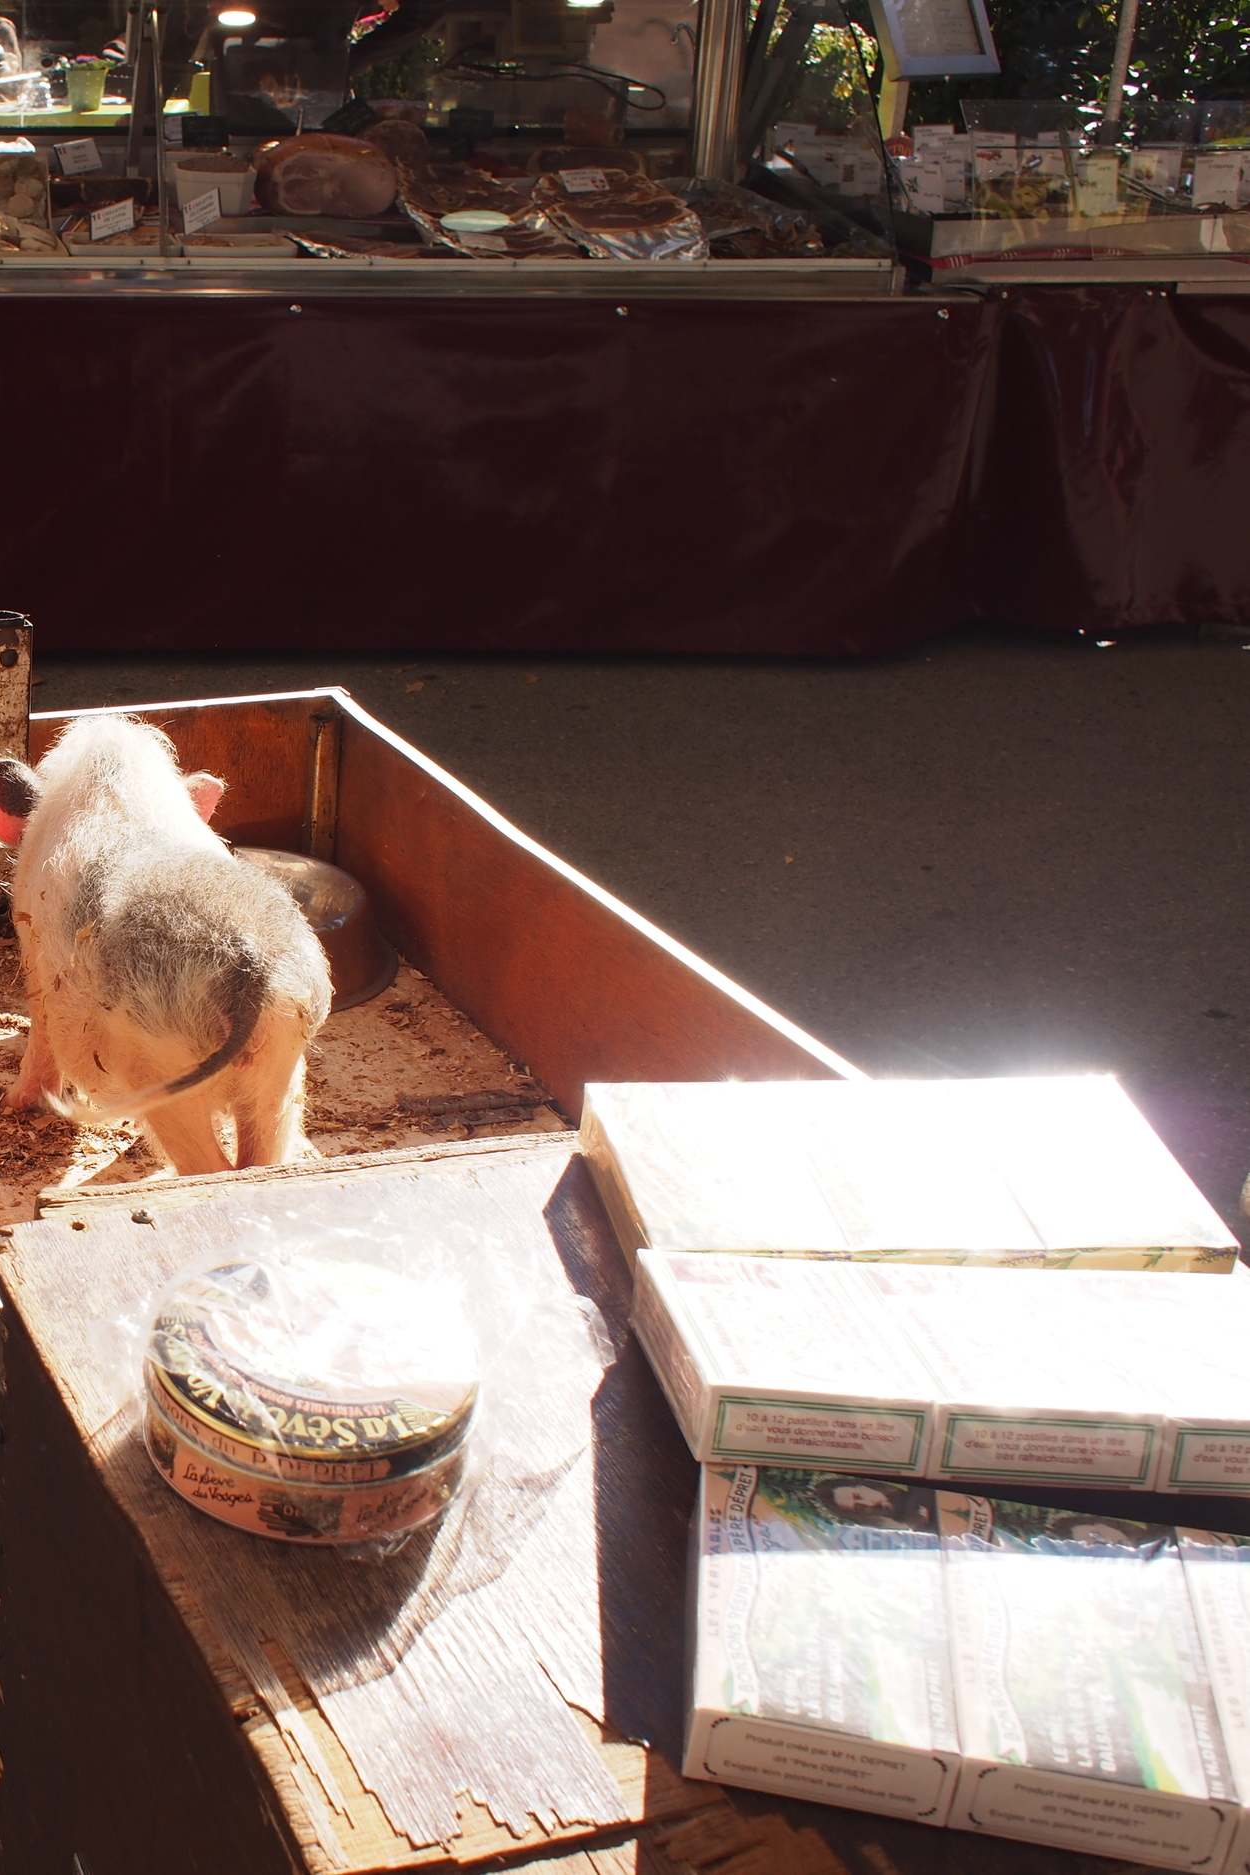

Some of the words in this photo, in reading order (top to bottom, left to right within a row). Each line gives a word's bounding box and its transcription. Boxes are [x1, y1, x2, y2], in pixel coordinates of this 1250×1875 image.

[263, 1407, 357, 1447] Sève
[358, 1414, 414, 1439] La
[746, 1413, 758, 1422] 10
[761, 1413, 768, 1423] à
[772, 1415, 784, 1424] 12
[787, 1416, 828, 1428] pastilles
[831, 1419, 857, 1430] dans
[860, 1422, 873, 1430] un
[876, 1421, 895, 1432] litre
[766, 1435, 786, 1445] très
[767, 1426, 791, 1435] vous
[794, 1427, 836, 1438] donnent
[839, 1431, 858, 1440] une
[861, 1431, 902, 1443] boisson
[975, 1430, 987, 1439] 10
[989, 1430, 997, 1440] à
[1001, 1431, 1013, 1440] 12
[1016, 1431, 1057, 1443] pastilles
[1061, 1433, 1086, 1444] dans
[1089, 1436, 1103, 1445] un
[212, 1436, 236, 1456] du
[995, 1443, 1020, 1451] vous
[1022, 1442, 1065, 1454] donnent
[1068, 1446, 1088, 1456] une
[1090, 1447, 1131, 1458] boisson
[995, 1451, 1015, 1462] très
[1204, 1444, 1216, 1453] 10
[1230, 1445, 1243, 1453] 12
[1193, 1454, 1221, 1463] d'eau
[183, 1462, 198, 1481] La
[198, 1466, 235, 1487] Sève
[208, 1486, 255, 1507] Vosges
[727, 1471, 753, 1512] DÉPRET
[729, 1515, 749, 1547] PÈRE
[726, 1562, 753, 1621] RÉSINEUX
[707, 1610, 720, 1637] LES
[725, 1623, 755, 1693] BONBONS
[982, 1669, 1021, 1742] BONBONS
[745, 1733, 784, 1748] Produit
[786, 1742, 809, 1754] créé
[810, 1747, 828, 1758] par
[772, 1754, 787, 1765] dit
[1075, 1748, 1094, 1767] LA
[723, 1759, 758, 1775] Exigez
[761, 1767, 782, 1777] son
[784, 1771, 823, 1786] portrait
[826, 1780, 843, 1789] sur
[846, 1784, 886, 1799] chaque
[1014, 1782, 1054, 1797] Produit
[1082, 1796, 1100, 1806] par
[1042, 1803, 1057, 1814] dit
[1029, 1816, 1050, 1826] son
[1052, 1820, 1094, 1836] portrait
[1096, 1829, 1116, 1839] sur
[1117, 1833, 1159, 1848] chaque
